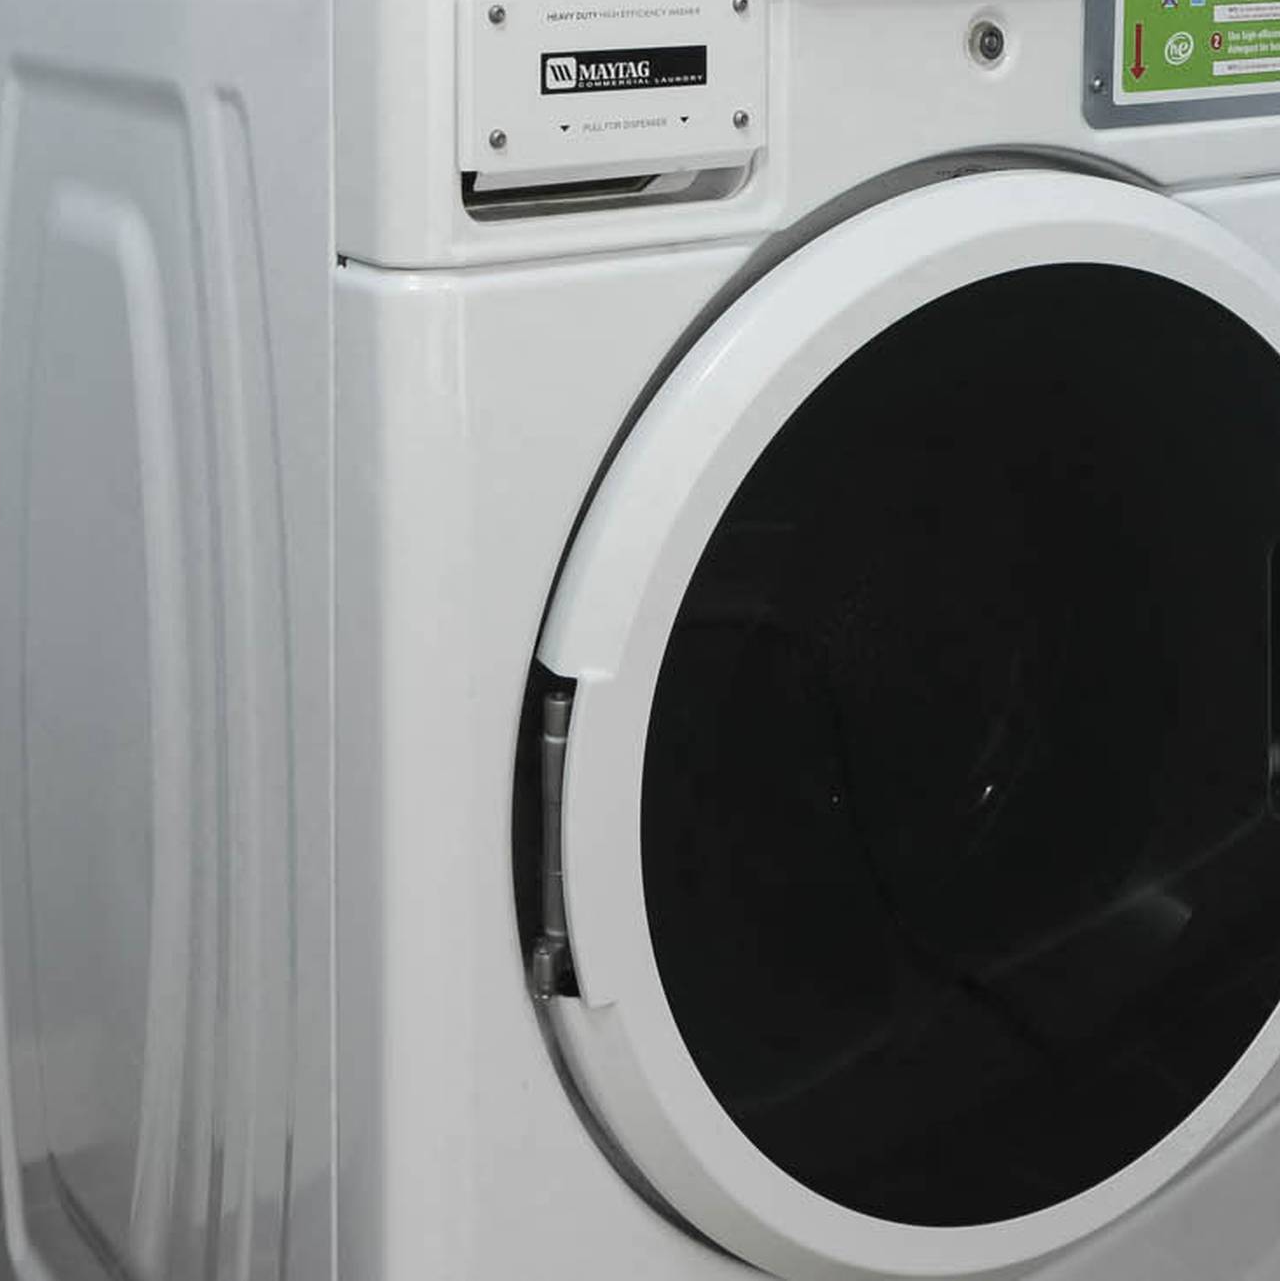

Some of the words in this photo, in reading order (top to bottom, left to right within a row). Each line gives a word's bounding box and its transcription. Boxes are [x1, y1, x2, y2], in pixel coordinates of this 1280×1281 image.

[579, 60, 650, 81] MAYTAG
[579, 78, 649, 88] COMMERCIAL
[655, 74, 704, 84] LAUNDRY
